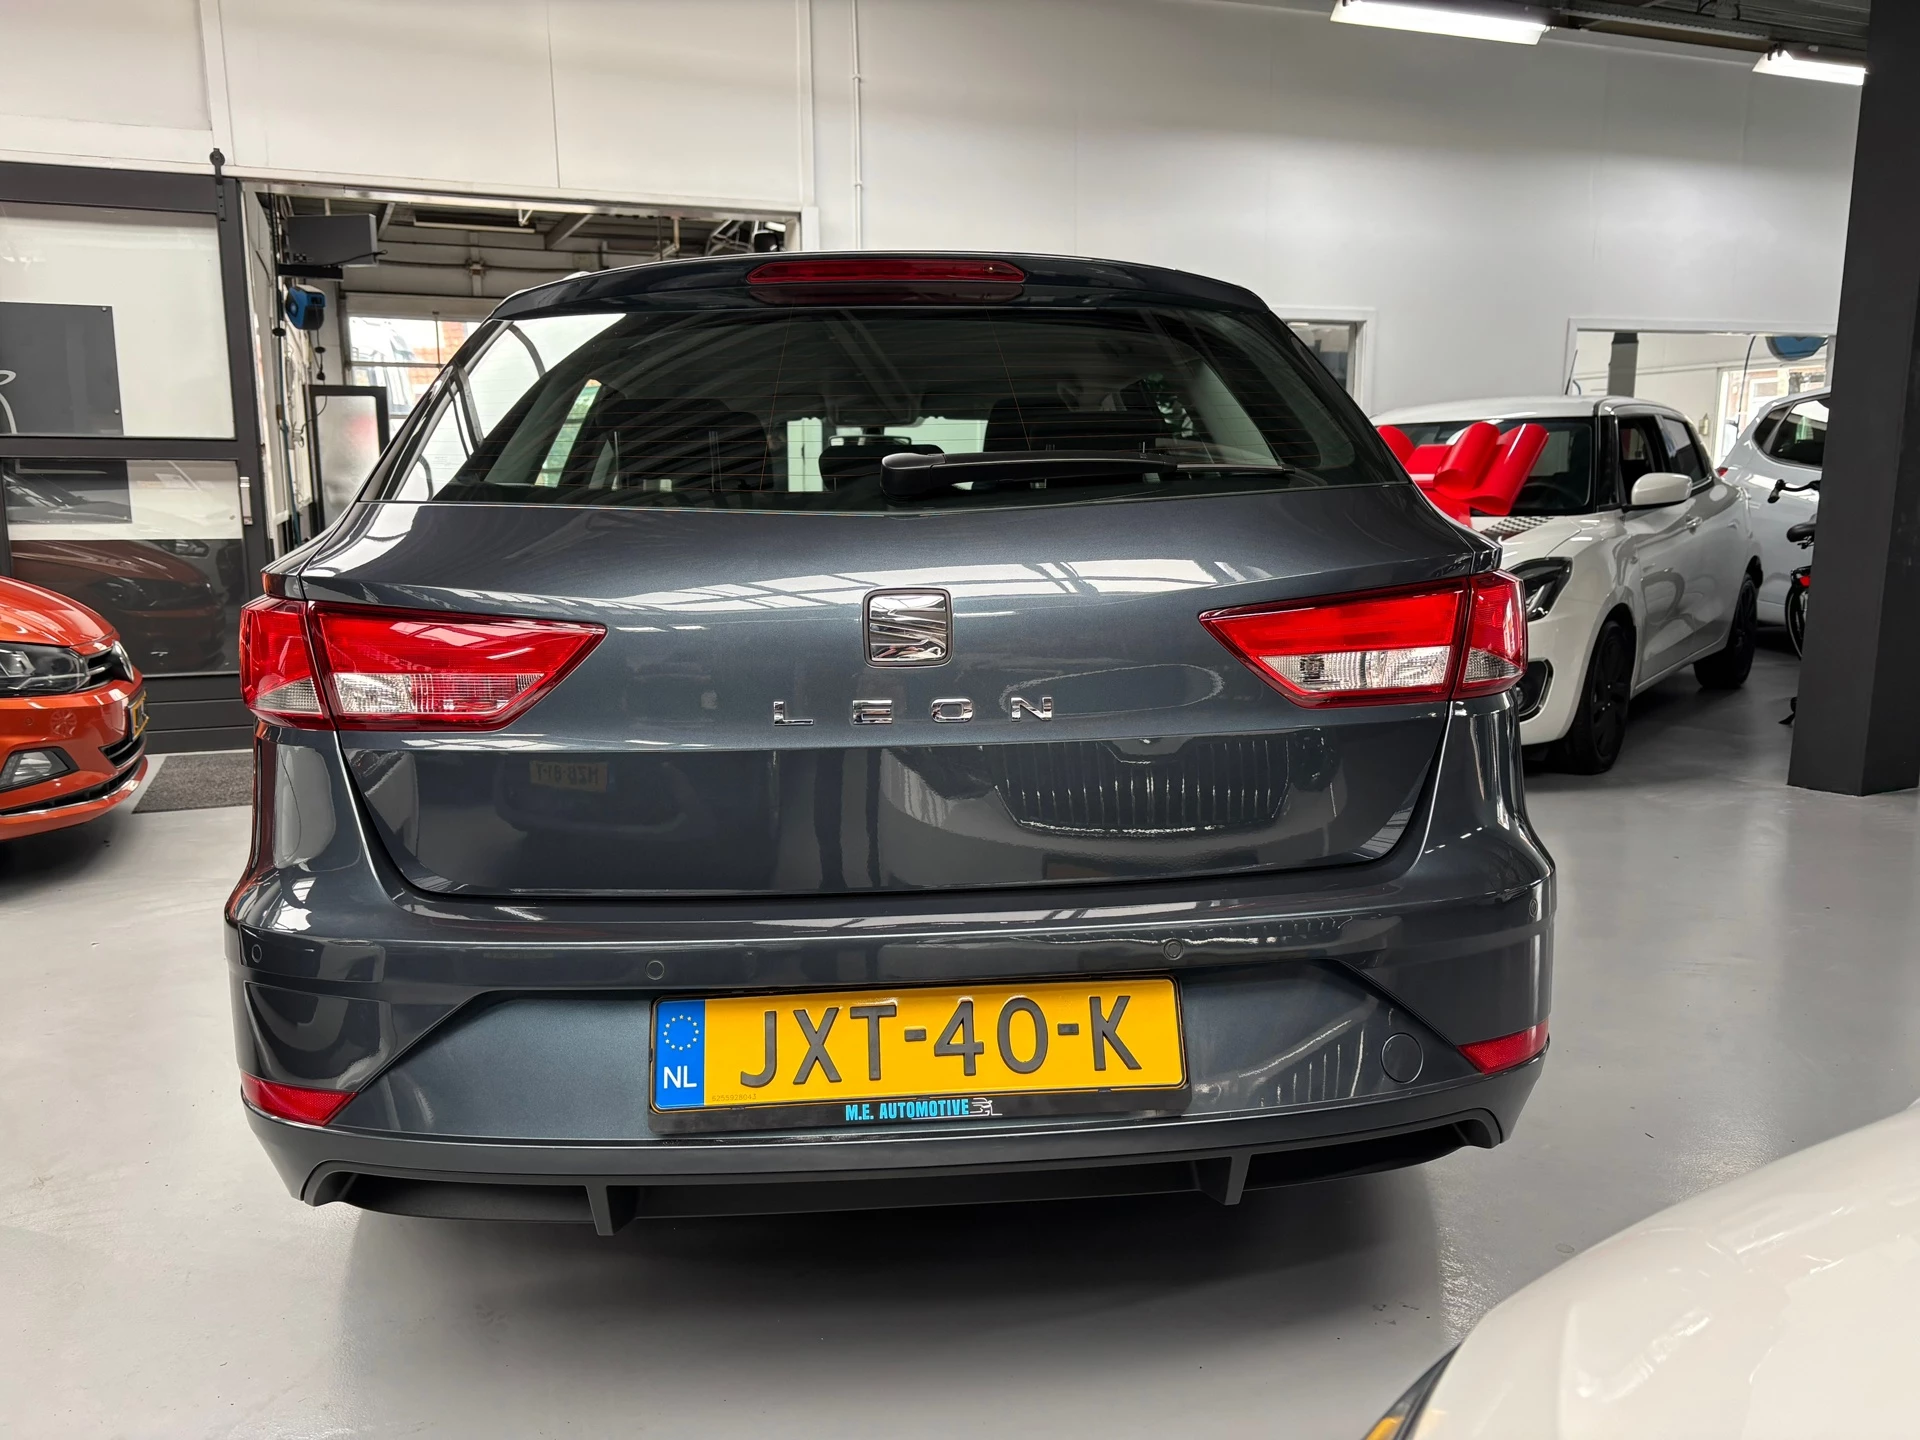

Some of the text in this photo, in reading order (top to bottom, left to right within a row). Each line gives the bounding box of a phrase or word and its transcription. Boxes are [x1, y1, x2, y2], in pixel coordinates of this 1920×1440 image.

[773, 696, 1052, 726] LEON
[740, 994, 1142, 1088] JXT-40-K
[663, 1065, 698, 1089] NL
[845, 1098, 969, 1121] M.E. AUTOMOTIVE
